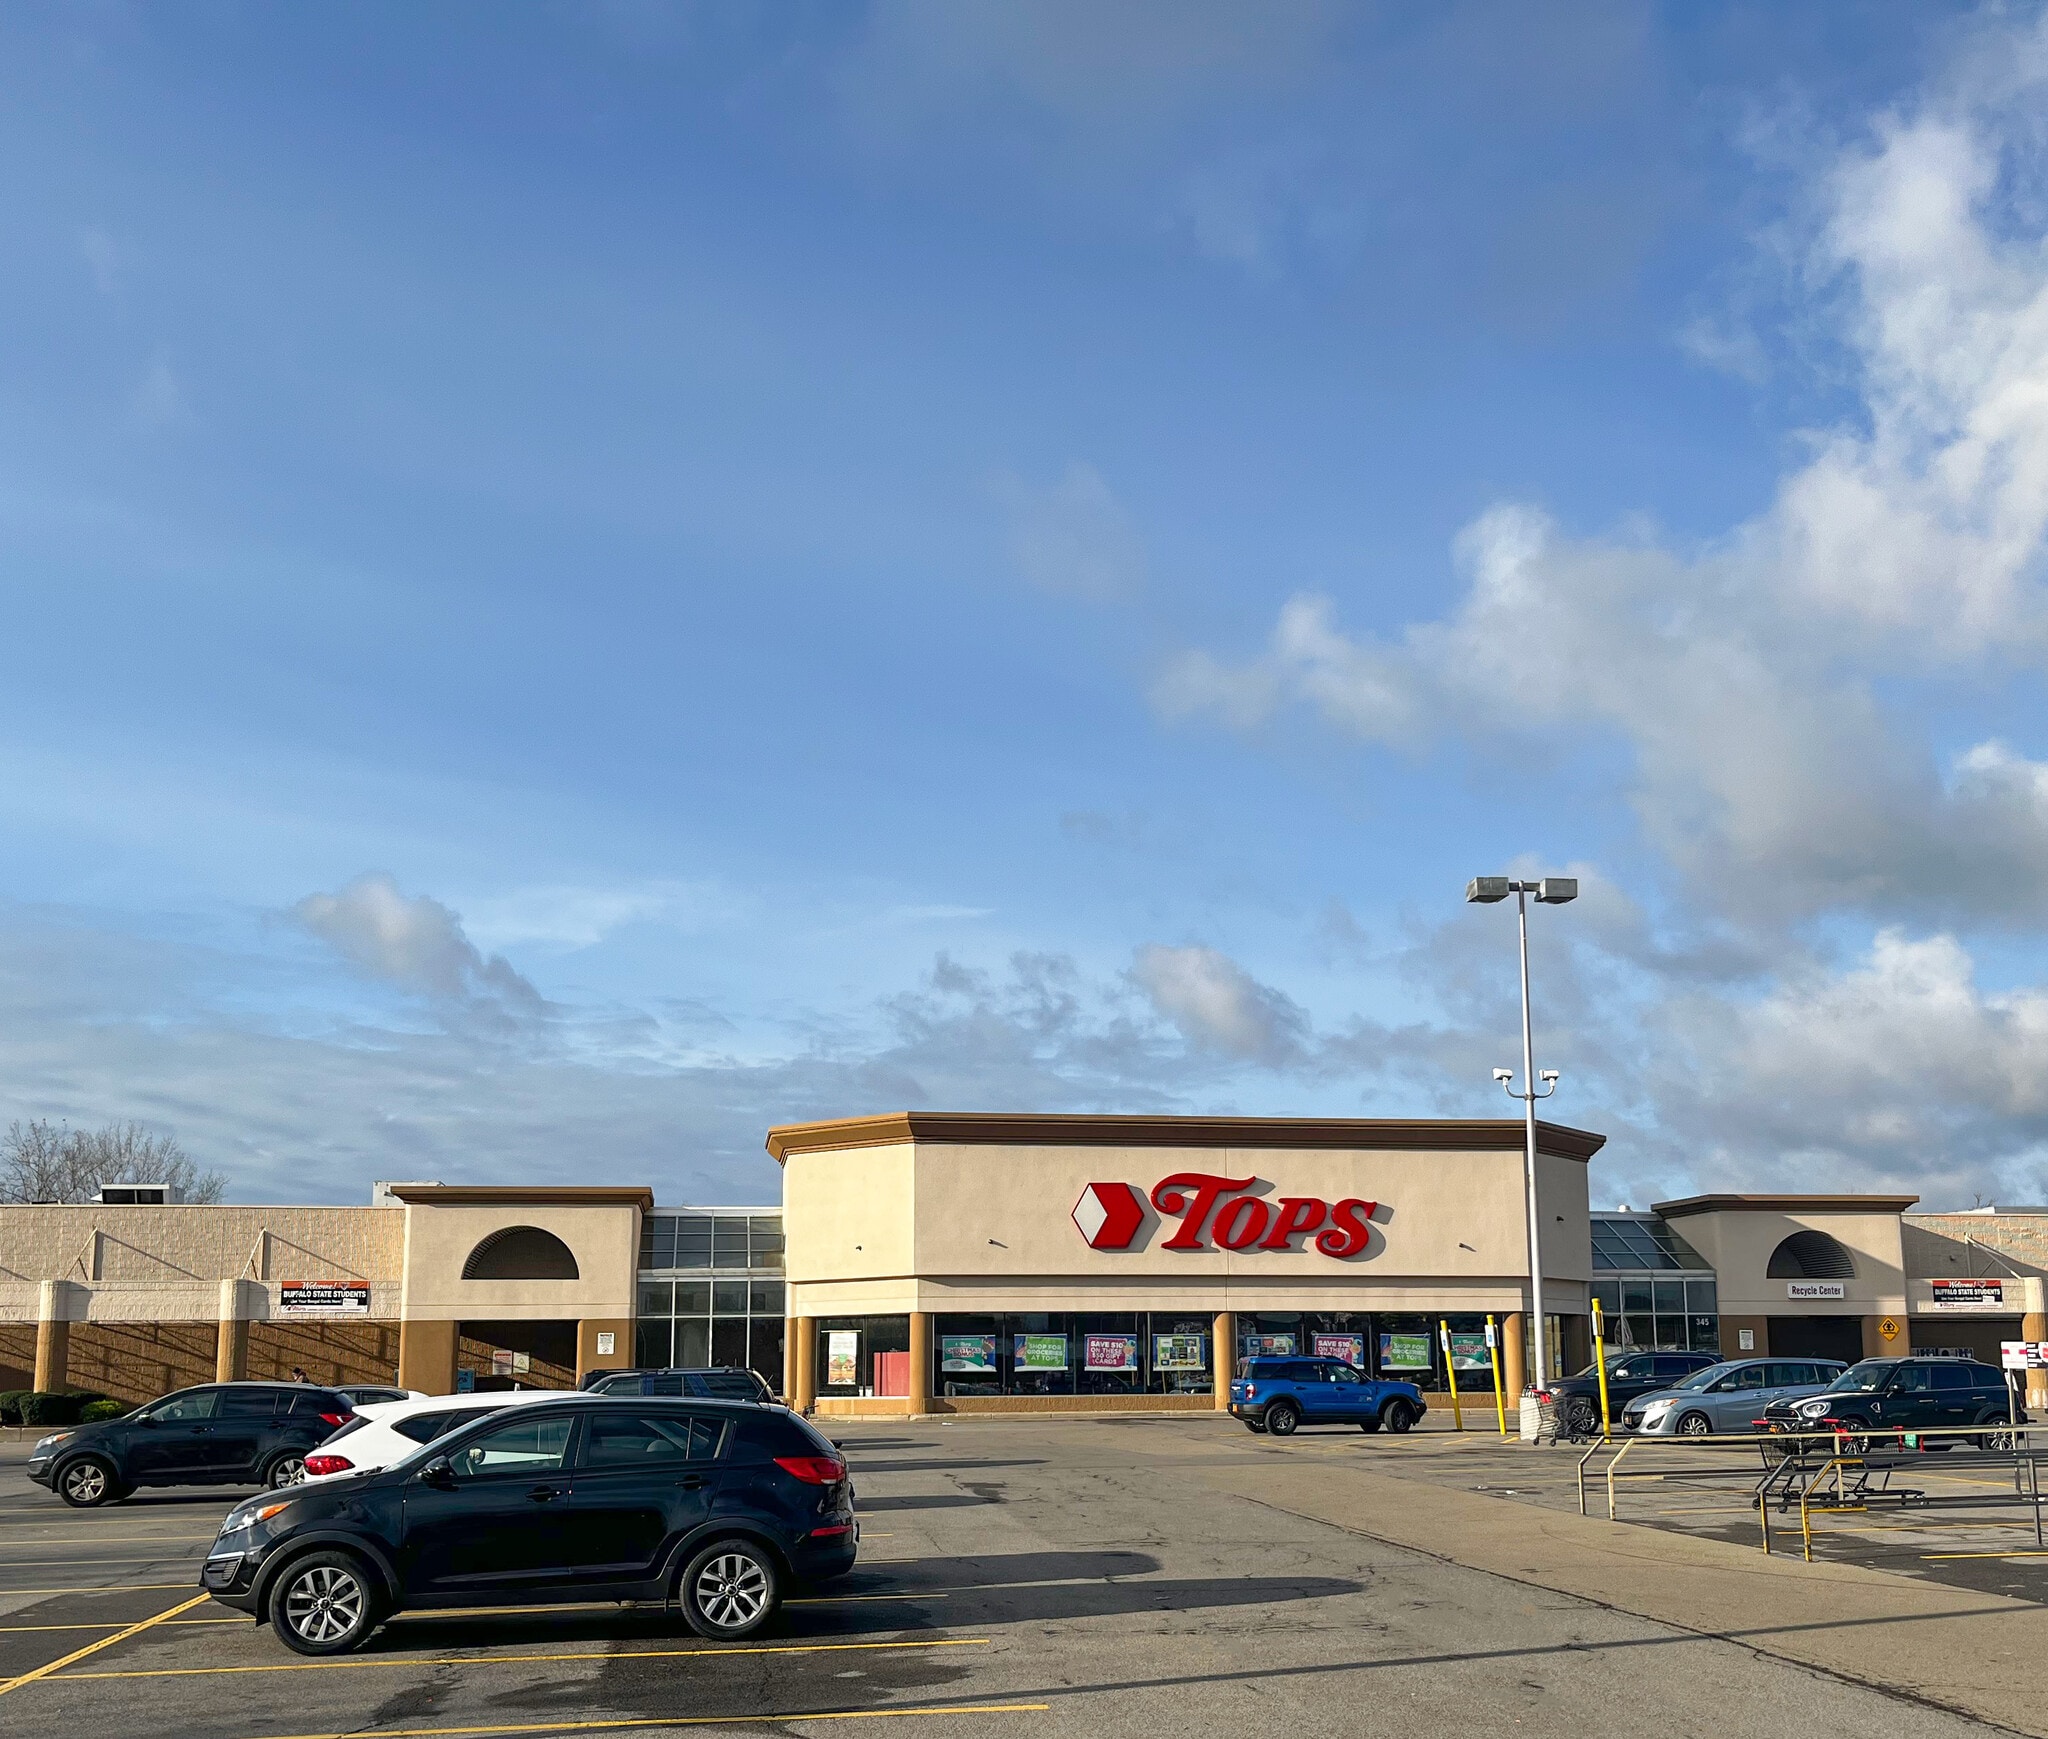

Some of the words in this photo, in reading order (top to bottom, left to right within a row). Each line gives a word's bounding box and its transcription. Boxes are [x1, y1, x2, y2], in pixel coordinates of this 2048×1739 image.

[1151, 1172, 1378, 1258] Tops
[301, 1281, 338, 1290] Welcome!
[283, 1290, 312, 1298] BUFFALO
[312, 1290, 332, 1298] STATE
[333, 1290, 367, 1298] STUDENTS
[1791, 1285, 1818, 1296] Recycle
[1819, 1285, 1841, 1295] Center
[1695, 1318, 1710, 1326] 345
